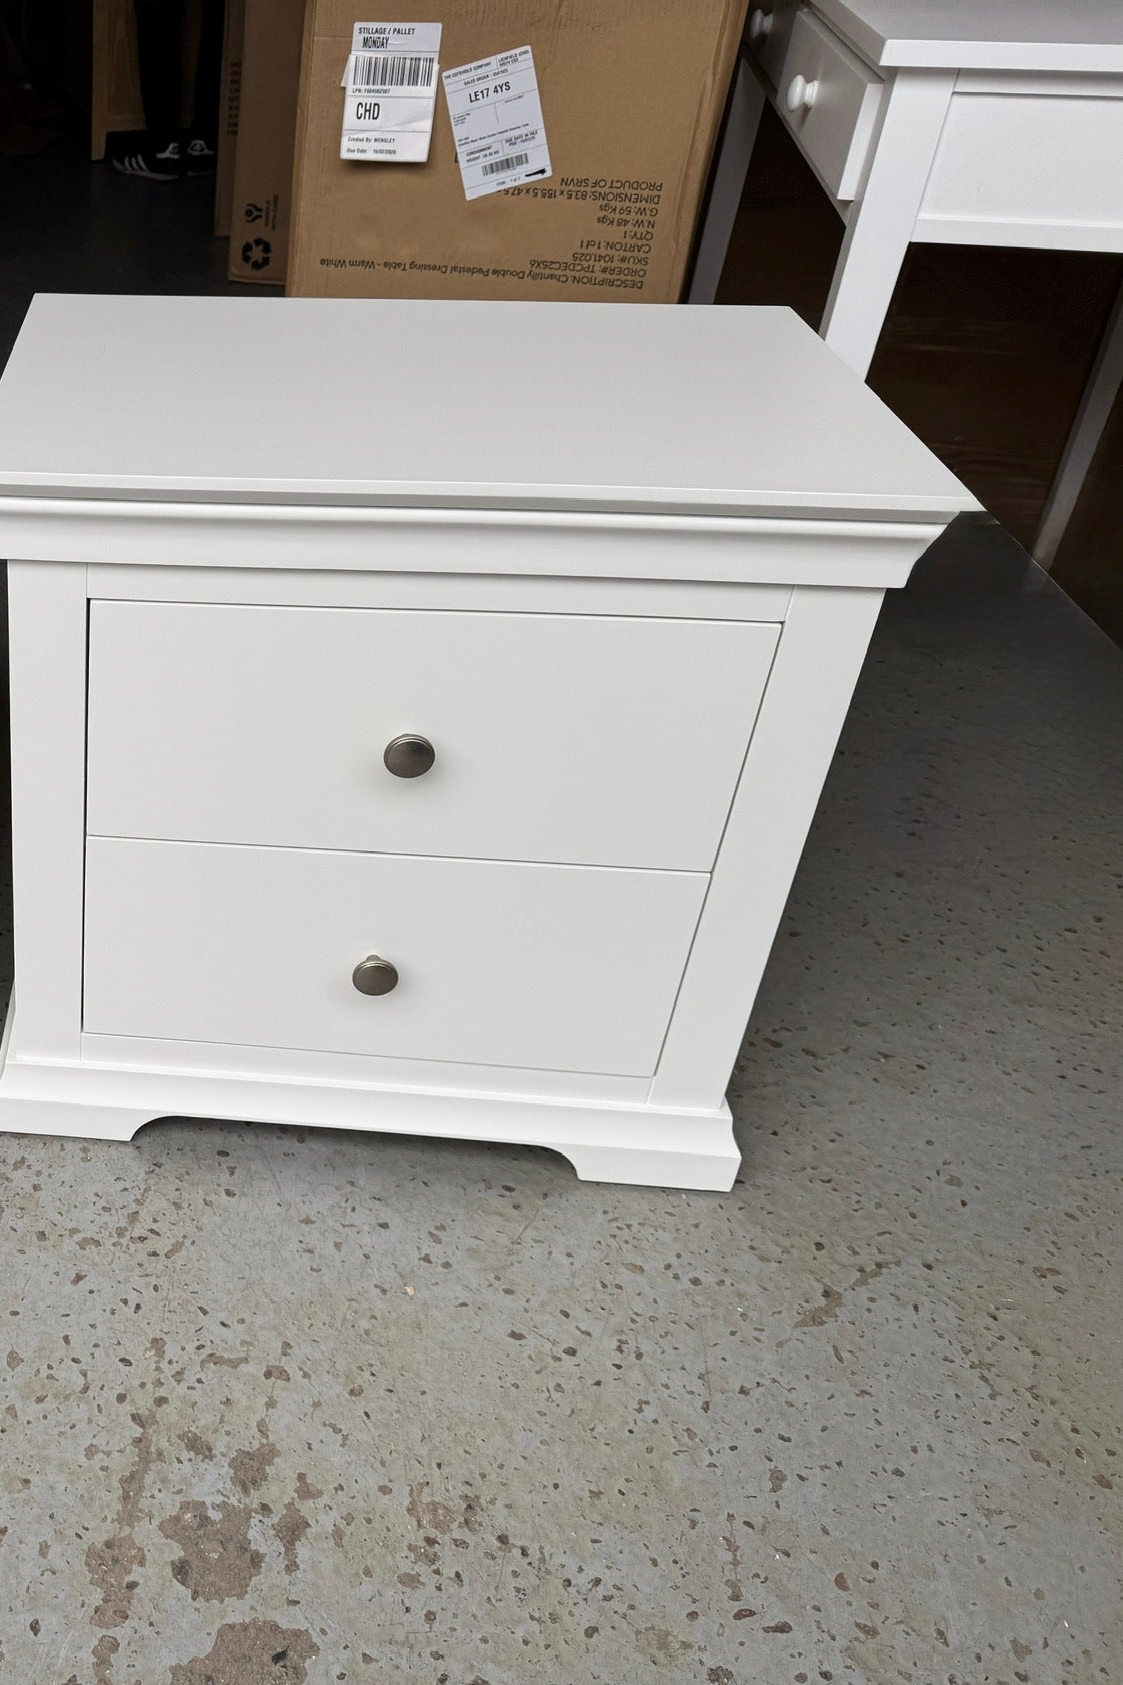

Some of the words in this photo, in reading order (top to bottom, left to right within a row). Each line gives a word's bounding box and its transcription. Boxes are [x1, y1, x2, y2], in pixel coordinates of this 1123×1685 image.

[358, 27, 387, 35] STILLAGE
[362, 36, 390, 49] MONDAY
[473, 62, 491, 71] COMPANY
[469, 88, 490, 103] LE17
[493, 81, 511, 94] 4YS
[356, 102, 380, 120] CHD
[561, 177, 590, 188] SRVN
[591, 178, 607, 189] OF
[609, 179, 663, 192] PRODUCT
[532, 188, 558, 199] 155.5
[566, 190, 587, 200] 83.5
[589, 191, 660, 205] DIMENSIONS:
[599, 204, 616, 215] Kgs
[618, 206, 631, 215] 59
[631, 207, 659, 217] G.W:
[596, 216, 614, 227] Kgs
[616, 218, 630, 227] 48
[631, 219, 655, 229] N.W:
[586, 240, 596, 249] of
[603, 241, 652, 254] CARTON:
[572, 252, 614, 263] 1041.025
[617, 255, 649, 266] SKU#:
[320, 258, 347, 269] White
[349, 259, 376, 270] Warm
[383, 260, 407, 271] Table
[409, 261, 448, 274] Dressing
[529, 259, 596, 274] TPCDEC25X6
[450, 266, 490, 277] Pedestal
[492, 268, 525, 279] Double
[527, 269, 569, 283] Chantilly
[600, 266, 647, 278] ORDER#:
[571, 276, 644, 290] DESCRIPTION:
